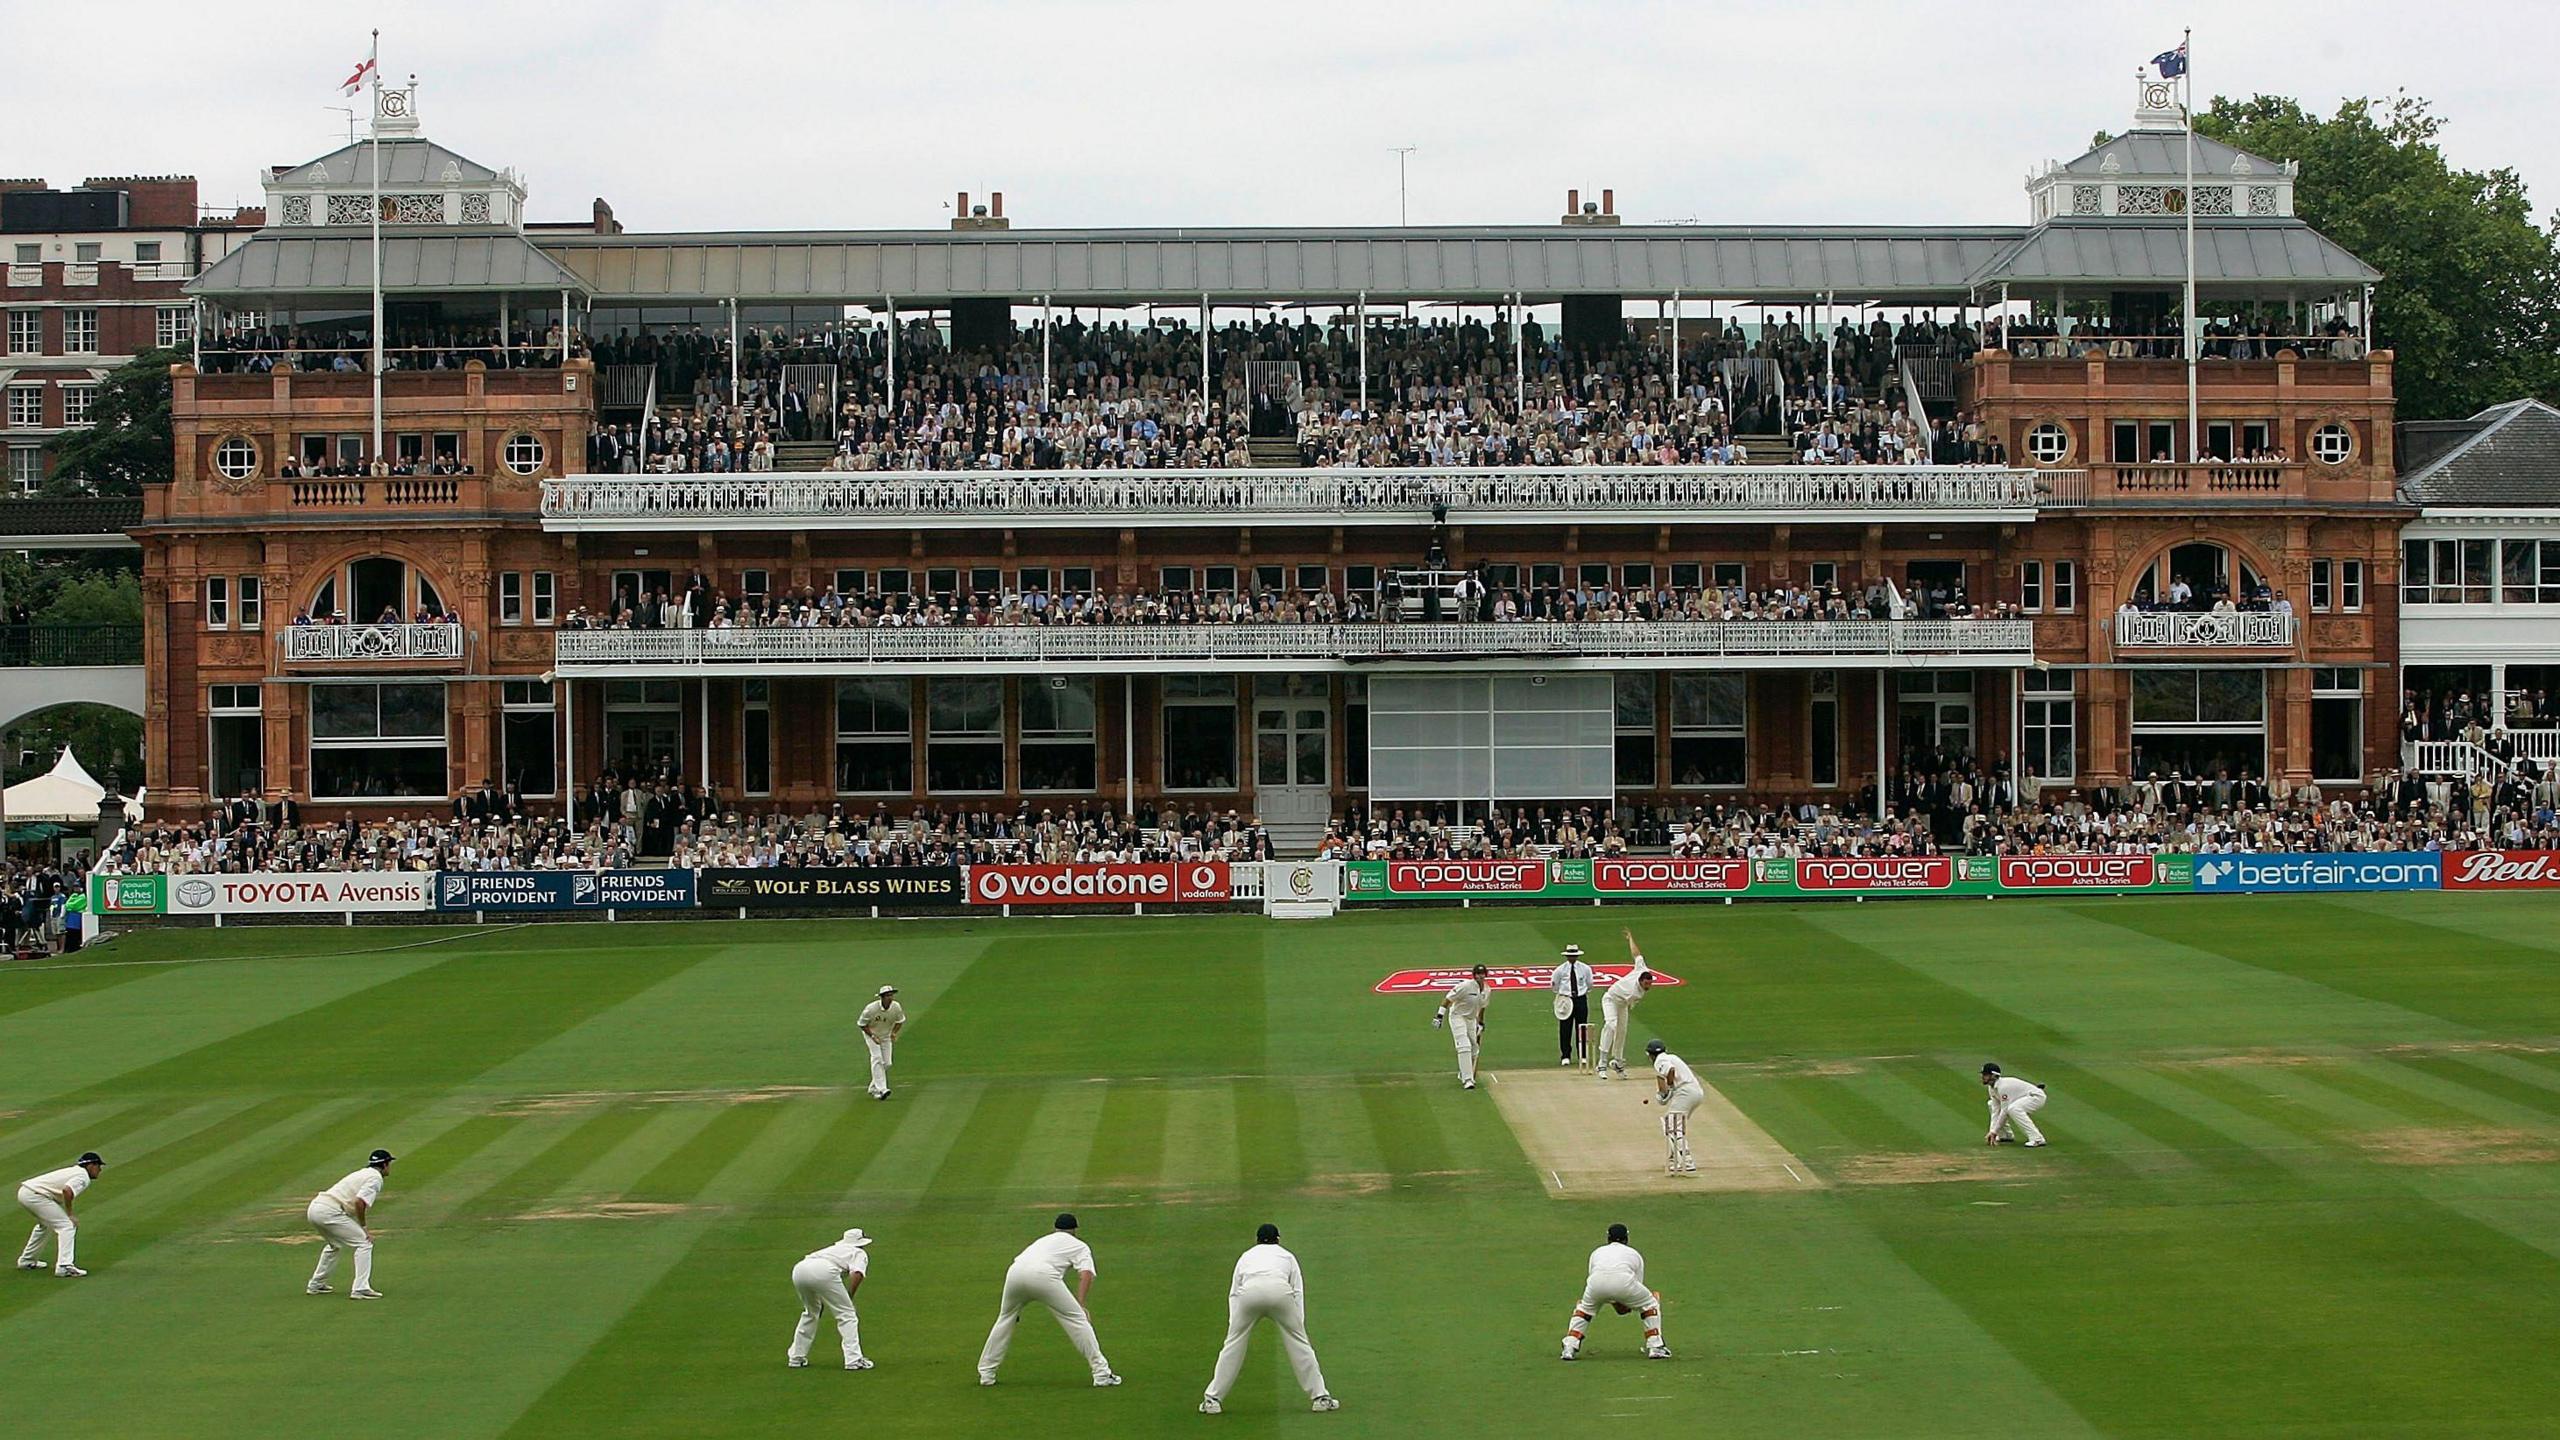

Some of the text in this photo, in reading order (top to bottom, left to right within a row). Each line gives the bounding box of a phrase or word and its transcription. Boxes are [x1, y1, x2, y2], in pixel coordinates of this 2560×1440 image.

[1806, 862, 1942, 886] npower
[2008, 860, 2144, 883] npower
[2239, 860, 2438, 885] betfair.com
[2453, 852, 2545, 882] Red
[472, 878, 535, 889] FRIENDS
[601, 876, 664, 888] FRIENDS
[1010, 868, 1168, 896] vodafone
[1399, 865, 1536, 889] npower
[1603, 864, 1740, 887] npower
[2072, 877, 2131, 885] Ashes Test Series
[122, 889, 151, 899] Ashes
[223, 882, 420, 903] TOYOTA Avensis
[754, 879, 951, 895] WOLF BLASS WINES
[1181, 888, 1226, 898] vodafone
[1462, 882, 1522, 890] Ashes Test Series
[472, 892, 557, 904] PROVIDENT
[601, 890, 686, 902] PROVIDENT
